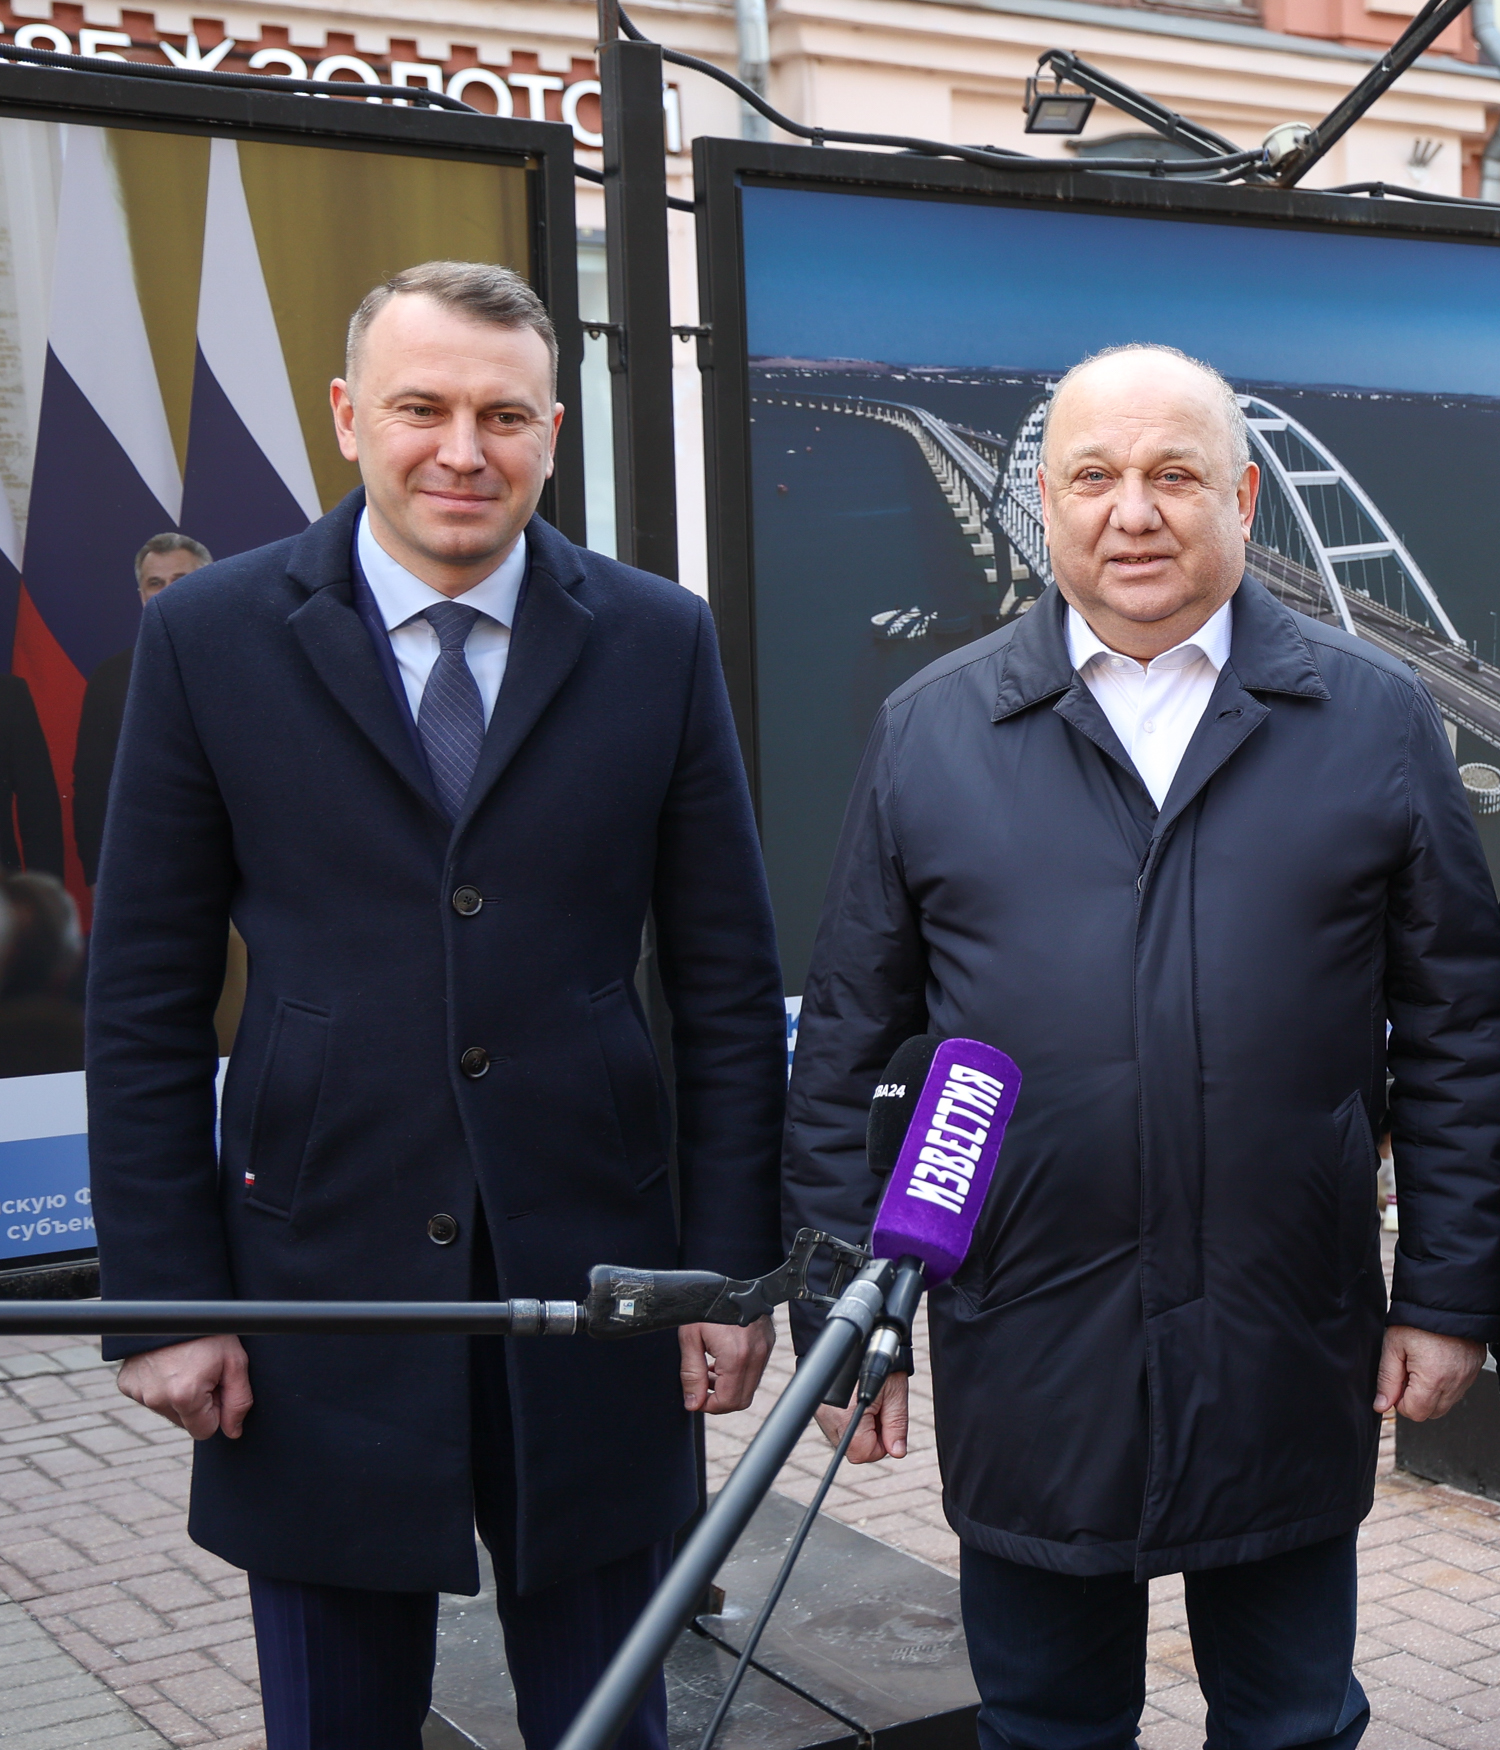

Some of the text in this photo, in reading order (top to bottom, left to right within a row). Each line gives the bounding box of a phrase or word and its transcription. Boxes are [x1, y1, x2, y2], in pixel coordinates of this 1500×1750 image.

[873, 1083, 906, 1099] ВА24
[906, 1063, 1004, 1214] ИЗВЕСТИЯ
[0, 1187, 91, 1214] скую Ф
[7, 1216, 96, 1241] субъек
